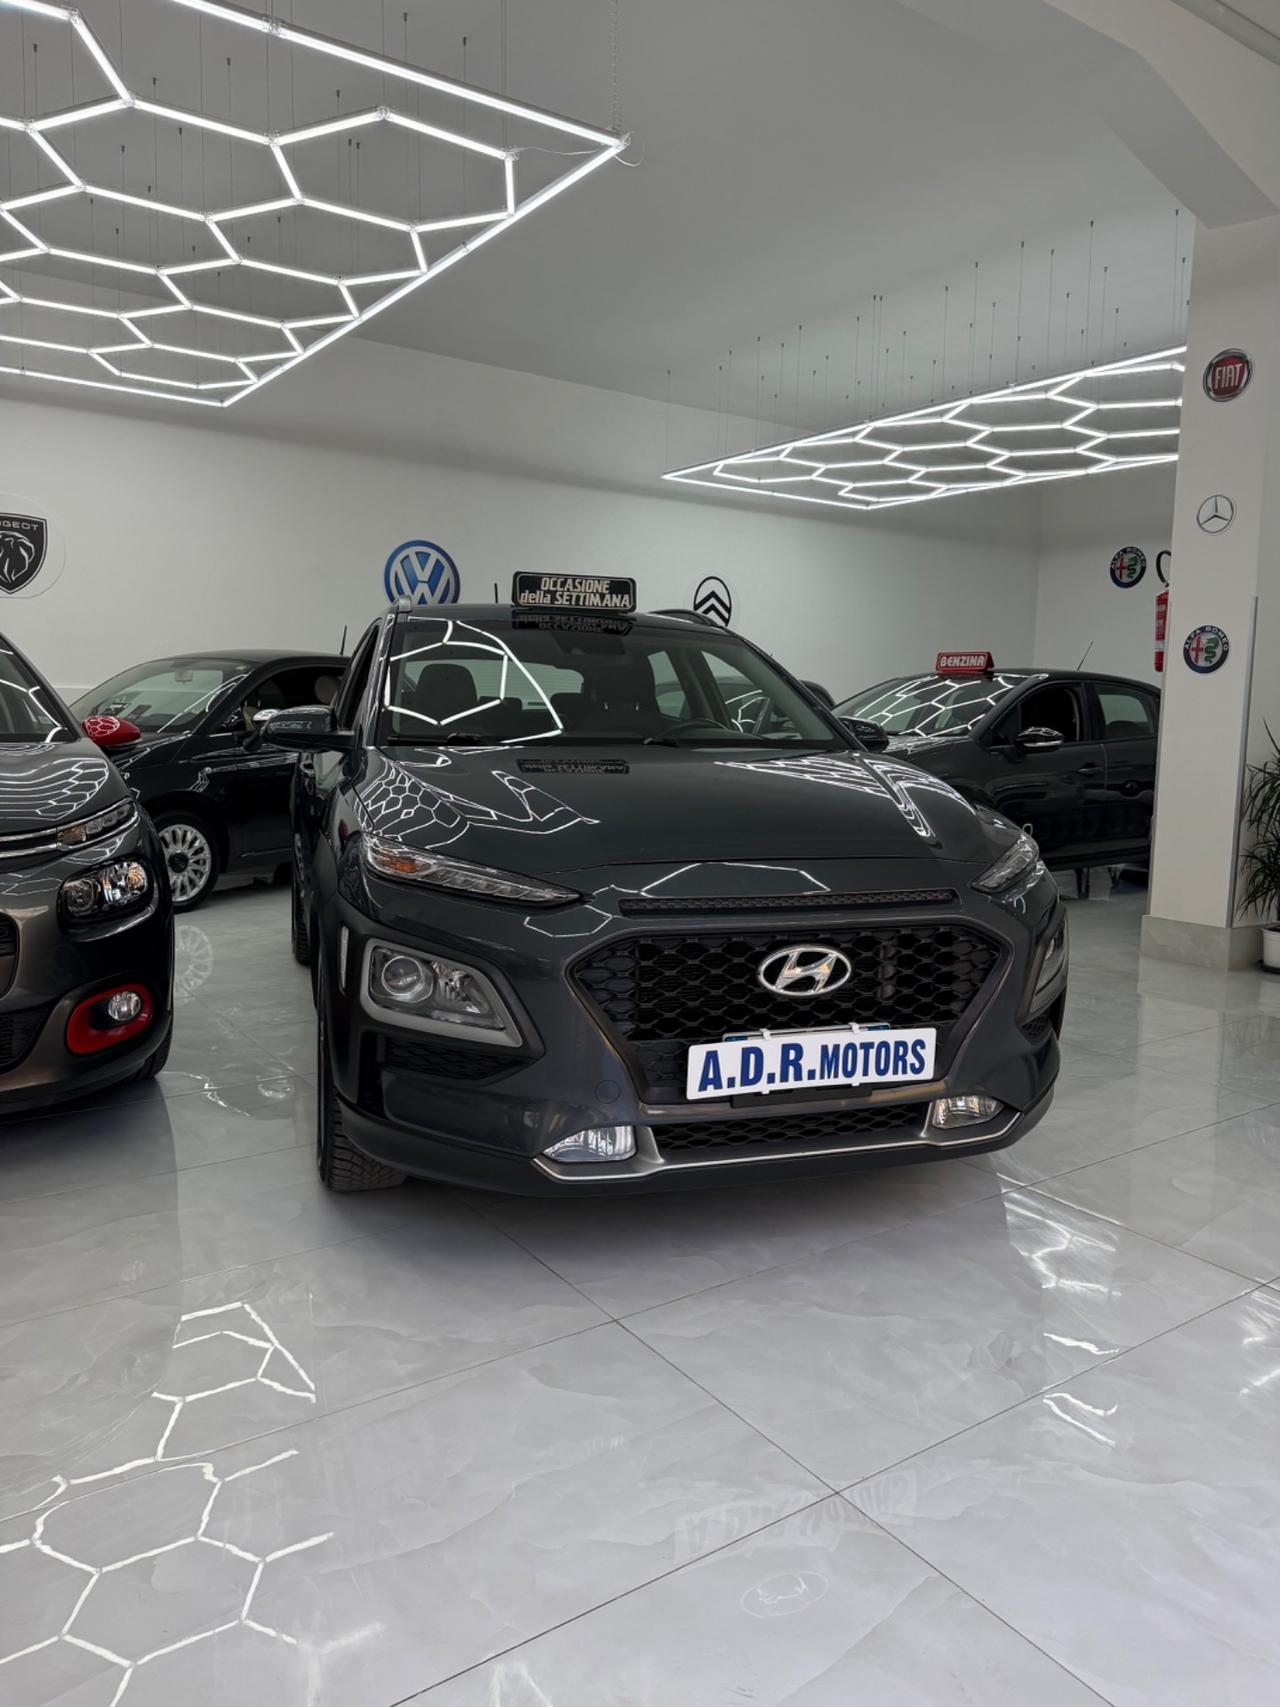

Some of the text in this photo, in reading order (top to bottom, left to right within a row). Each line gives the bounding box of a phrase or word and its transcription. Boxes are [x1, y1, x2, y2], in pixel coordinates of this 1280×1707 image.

[1214, 363, 1243, 389] FIAT
[541, 577, 611, 593] OCCASIONE
[520, 589, 630, 607] della SETTIMANA
[940, 655, 985, 667] BENZINA
